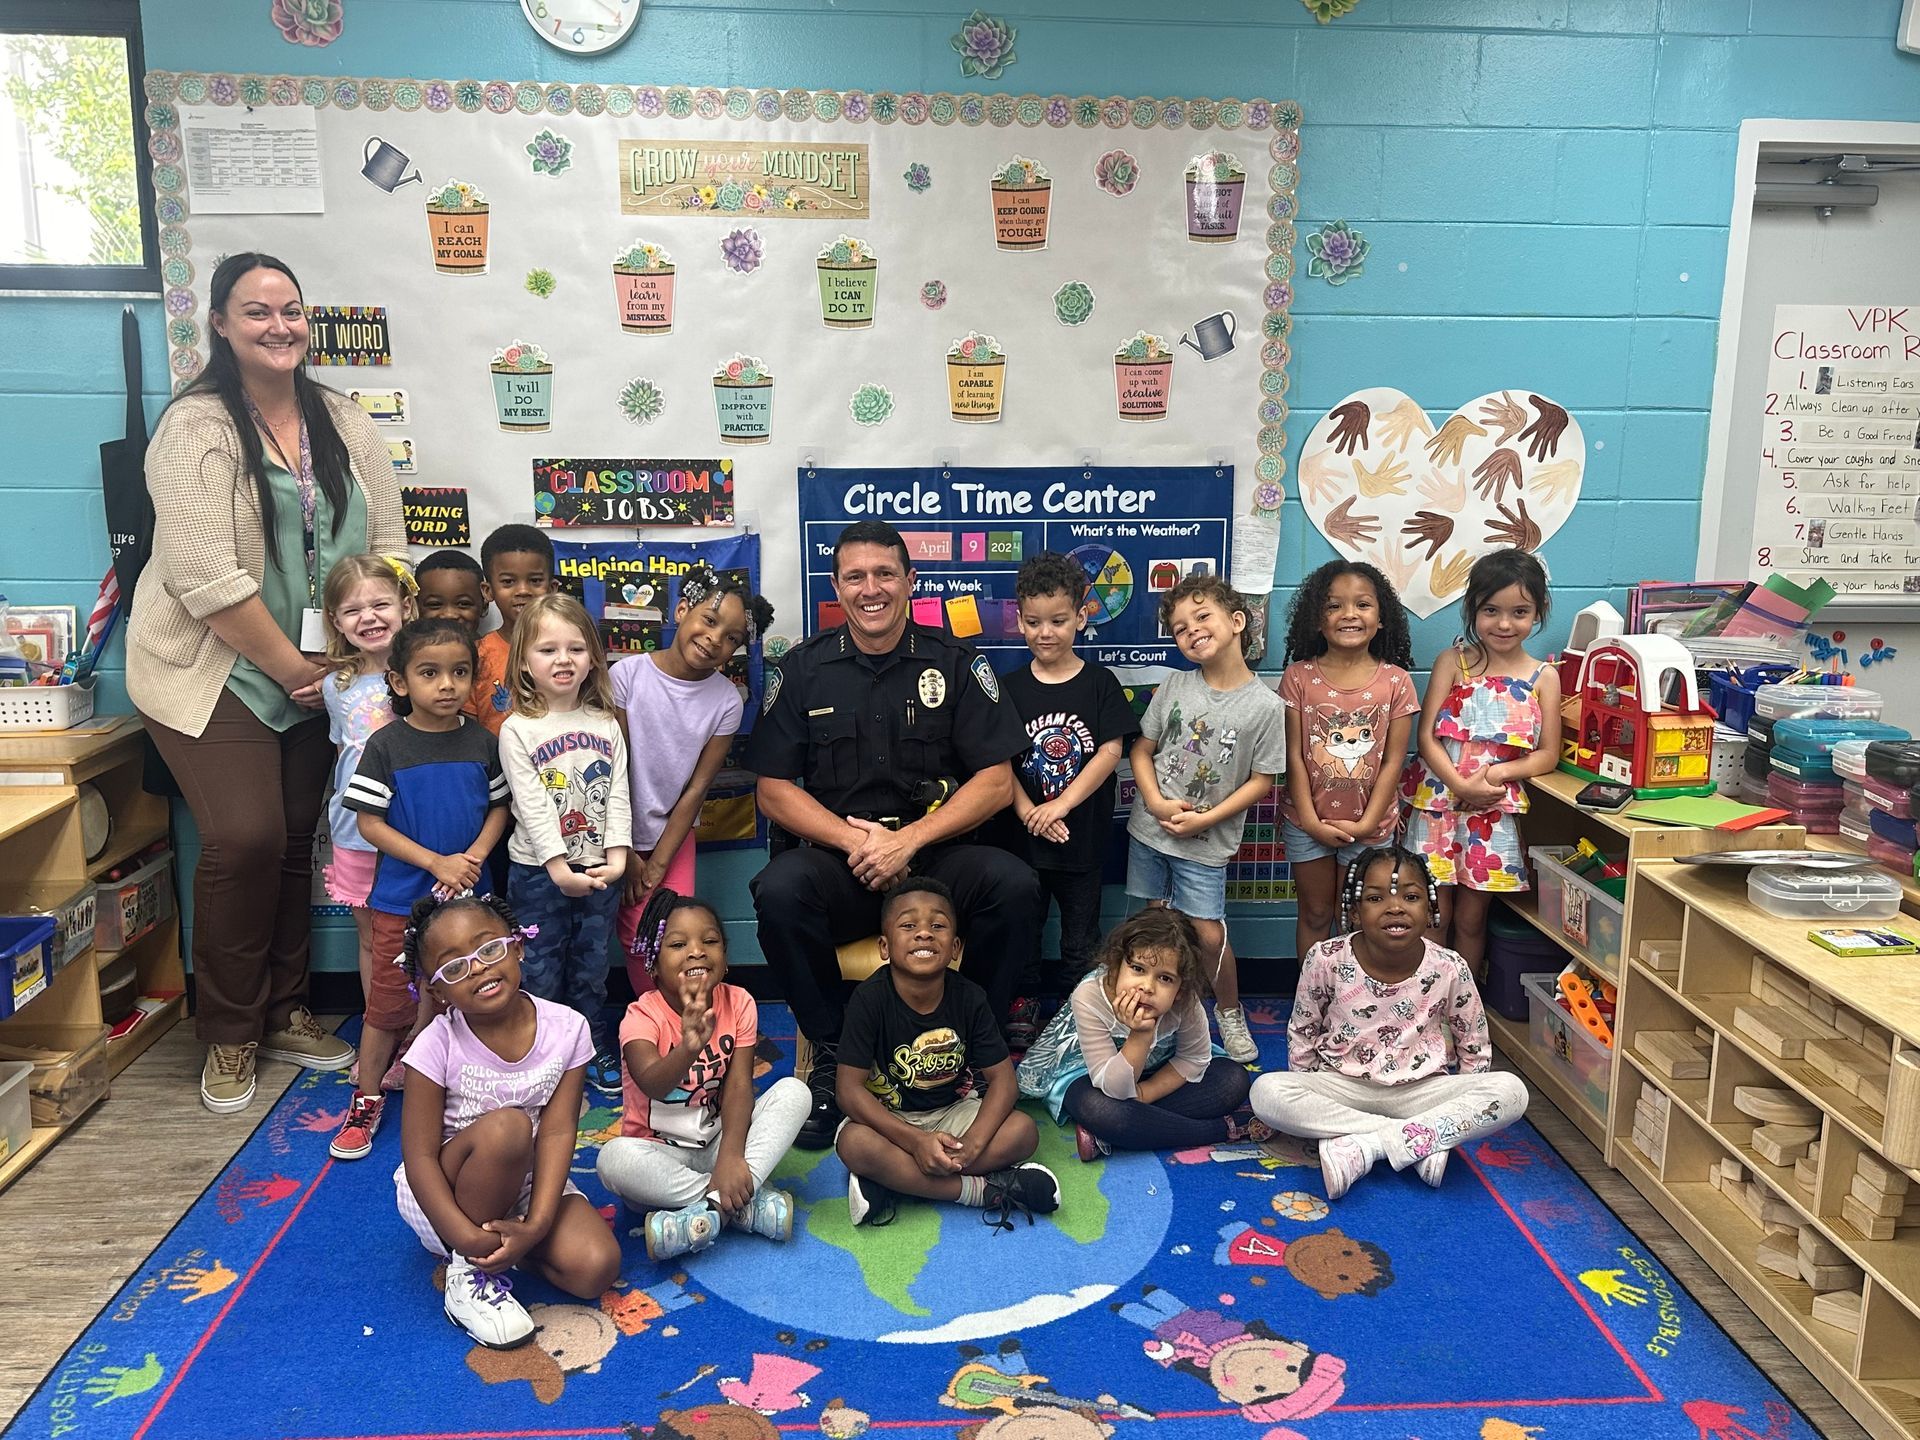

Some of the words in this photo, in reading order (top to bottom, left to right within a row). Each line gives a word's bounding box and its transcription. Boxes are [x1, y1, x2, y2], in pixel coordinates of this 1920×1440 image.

[554, 19, 562, 35] 7
[573, 27, 584, 44] 6
[628, 148, 699, 195] GROW
[703, 151, 757, 179] your
[762, 150, 861, 199] MINDSET
[997, 207, 1017, 215] KEEP
[1020, 207, 1046, 215] GOING
[445, 221, 449, 233] I
[454, 224, 474, 233] can
[1016, 218, 1033, 226] things
[1035, 218, 1044, 226] get
[438, 236, 482, 246] REACH
[437, 250, 451, 258] MY
[453, 250, 484, 258] GOALS.
[634, 279, 637, 288] I
[640, 281, 656, 289] can
[828, 277, 832, 287] I
[835, 277, 867, 287] believe
[630, 289, 661, 301] learn
[835, 291, 838, 299] I
[841, 291, 861, 299] CAN
[627, 301, 648, 310] from
[652, 303, 665, 313] my
[828, 304, 848, 313] DO
[1848, 308, 1908, 332] VPK
[335, 323, 384, 350] WORD
[1774, 331, 1891, 360] Classroom
[1124, 368, 1127, 376] I
[507, 381, 511, 392] I
[516, 381, 539, 393] will
[1129, 379, 1139, 387] up
[1142, 377, 1158, 386] with
[1800, 371, 1807, 390] 1.
[1837, 376, 1888, 392] Listening
[1893, 377, 1914, 389] Ears
[515, 396, 532, 404] DO
[735, 392, 738, 400] I
[957, 390, 965, 398] of
[967, 390, 995, 400] learning
[1123, 388, 1164, 399] creative
[1122, 401, 1164, 409] SOLUTIONS.
[1765, 393, 1779, 415] 2.
[1784, 394, 1822, 413] Always
[1862, 406, 1873, 415] up
[1881, 402, 1909, 414] after
[504, 408, 518, 416] MY
[521, 408, 545, 416] BEST.
[736, 413, 754, 421] with
[1780, 420, 1797, 442] 3.
[1818, 425, 1834, 438] Be
[1843, 430, 1850, 439] a
[1857, 427, 1879, 440] Good
[1883, 430, 1912, 441] Friend
[1762, 448, 1778, 468] 4.
[1787, 447, 1814, 464] Cover
[1818, 456, 1840, 467] your
[1845, 451, 1873, 467] coughs
[1879, 450, 1896, 464] and
[550, 470, 710, 494] CLASSROOM
[1783, 472, 1798, 489] 5.
[1823, 472, 1850, 488] Ask
[1858, 473, 1875, 489] for
[1887, 474, 1911, 491] help
[843, 481, 942, 515] Circle
[951, 483, 1033, 515] Time
[1042, 482, 1156, 514] Center
[403, 505, 463, 518] YMING
[602, 498, 676, 521] JOBS
[1786, 496, 1800, 514] 6.
[1827, 497, 1876, 516] Walking
[1881, 499, 1912, 514] Feet
[1071, 525, 1114, 537] What's
[1117, 524, 1137, 536] the
[1140, 523, 1201, 537] Weather?
[1794, 524, 1805, 540] 7.
[1828, 523, 1867, 539] Gentle
[1873, 524, 1903, 540] Hands
[918, 540, 950, 556] April
[969, 541, 978, 553] 9
[991, 541, 1021, 554] 2024
[1758, 547, 1773, 567] 8.
[1800, 548, 1830, 564] Share
[1840, 551, 1859, 564] and
[1869, 550, 1892, 563] take
[559, 556, 644, 581] Helping
[923, 580, 944, 592] the
[947, 579, 983, 592] Week
[1843, 581, 1867, 592] your
[1873, 580, 1900, 590] hands
[607, 635, 656, 652] Line
[1098, 650, 1126, 662] Let's
[1130, 650, 1167, 662] Count
[1025, 713, 1066, 738] CREAM
[1065, 714, 1095, 753] CRUISE
[1122, 786, 1136, 798] 30
[1260, 828, 1271, 838] 63
[1242, 847, 1253, 857] 72
[1259, 847, 1270, 857] 73
[1275, 866, 1287, 876] 84
[1240, 885, 1252, 895] 92
[1257, 885, 1269, 895] 93
[1274, 885, 1286, 895] 94
[1291, 885, 1297, 895] 9
[462, 1064, 500, 1079] FOLLOW
[460, 1074, 494, 1092] FOLLO
[1238, 1237, 1279, 1256] 4
[1616, 1246, 1681, 1358] RESPONSIBLE
[51, 1342, 108, 1438] POSITIVE
